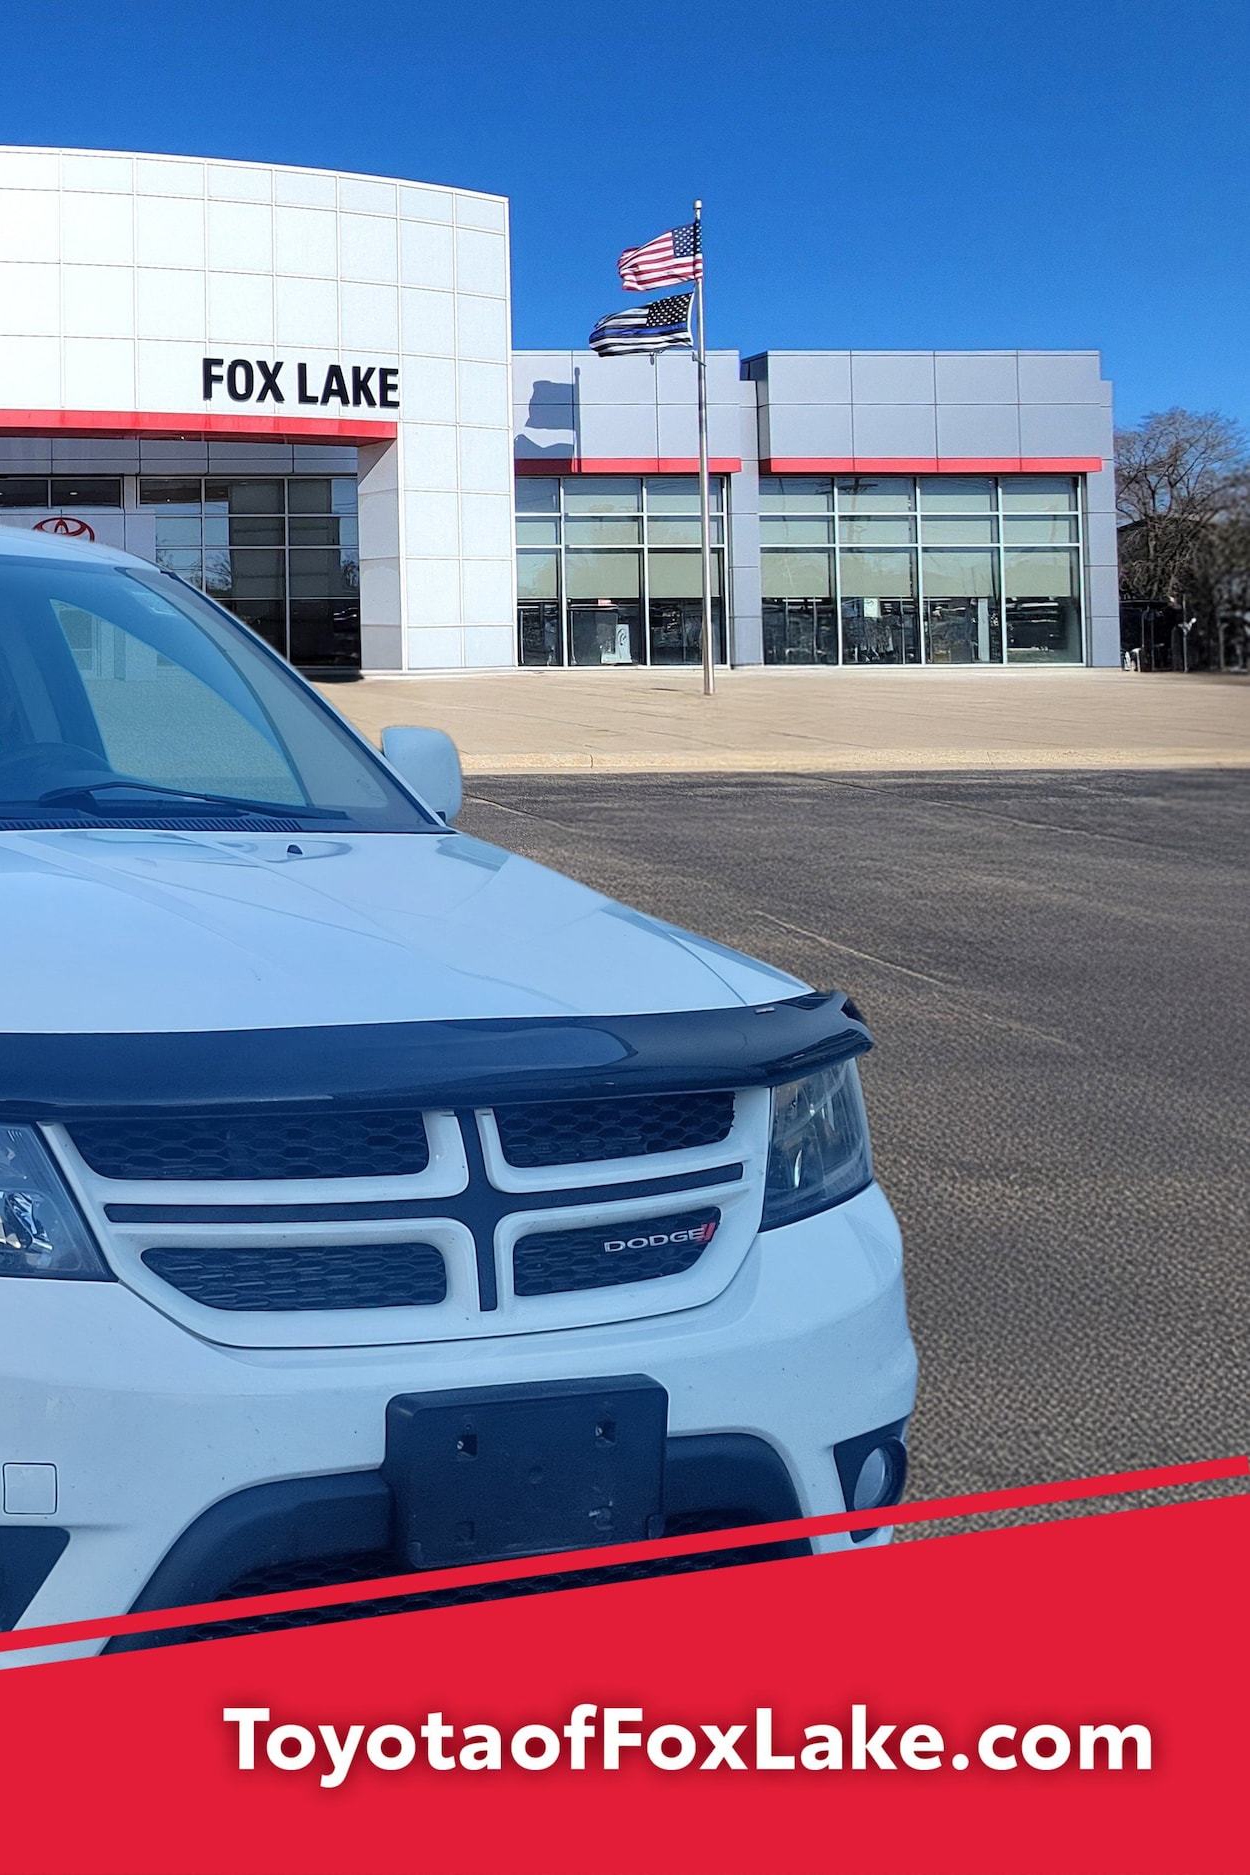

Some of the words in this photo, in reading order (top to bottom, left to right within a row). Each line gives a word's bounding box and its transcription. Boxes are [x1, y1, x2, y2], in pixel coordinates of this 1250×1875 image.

[202, 357, 285, 404] FOX
[297, 361, 400, 408] LAKE
[603, 1227, 705, 1253] DODGE
